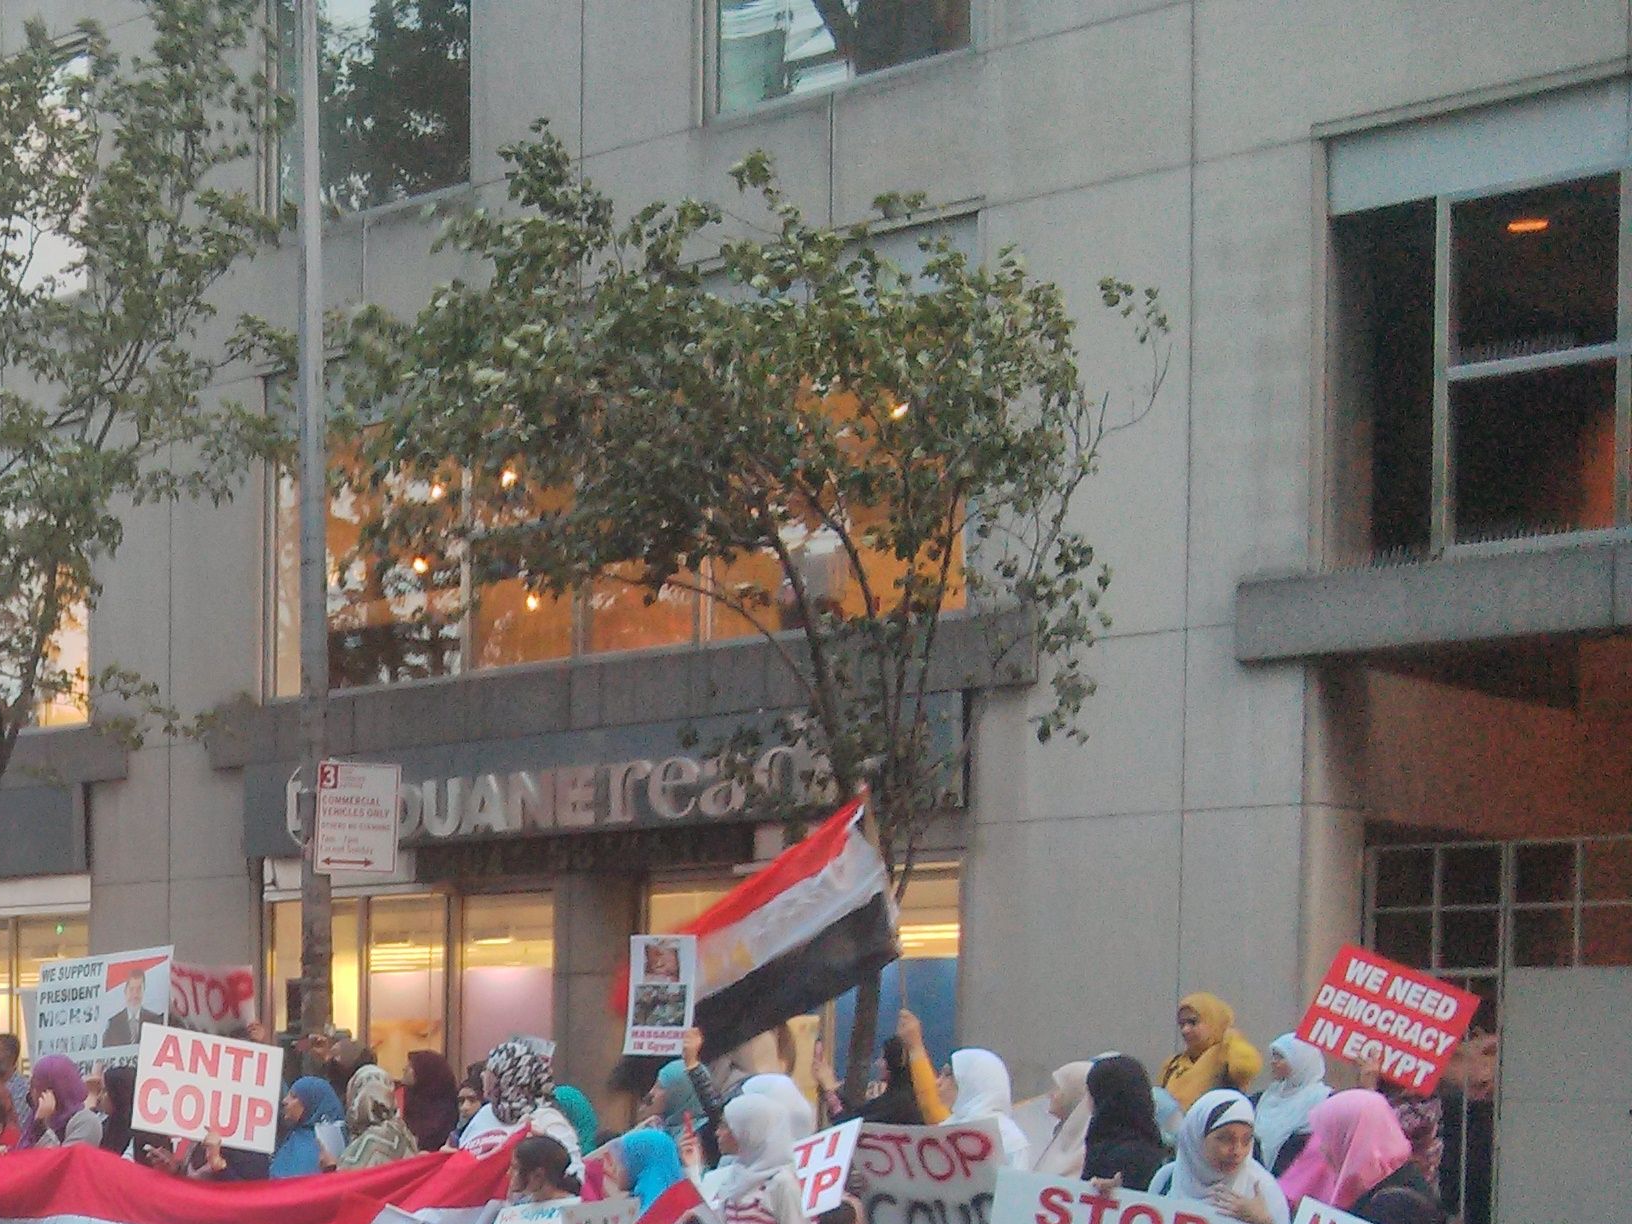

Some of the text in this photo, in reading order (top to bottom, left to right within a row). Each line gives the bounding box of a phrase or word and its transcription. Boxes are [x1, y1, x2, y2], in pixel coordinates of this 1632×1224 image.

[323, 765, 337, 787] 3
[39, 984, 101, 1005] PRESIDENT
[59, 961, 104, 980] SUPPORT
[170, 965, 255, 1021] STOP
[1345, 958, 1458, 1021] WE NEED
[1316, 983, 1456, 1057] DEMOCRACY
[152, 1034, 268, 1087] ANTI
[1308, 1017, 1436, 1087] IN EGYPT
[137, 1077, 273, 1142] COUP
[857, 1129, 993, 1182] STOP
